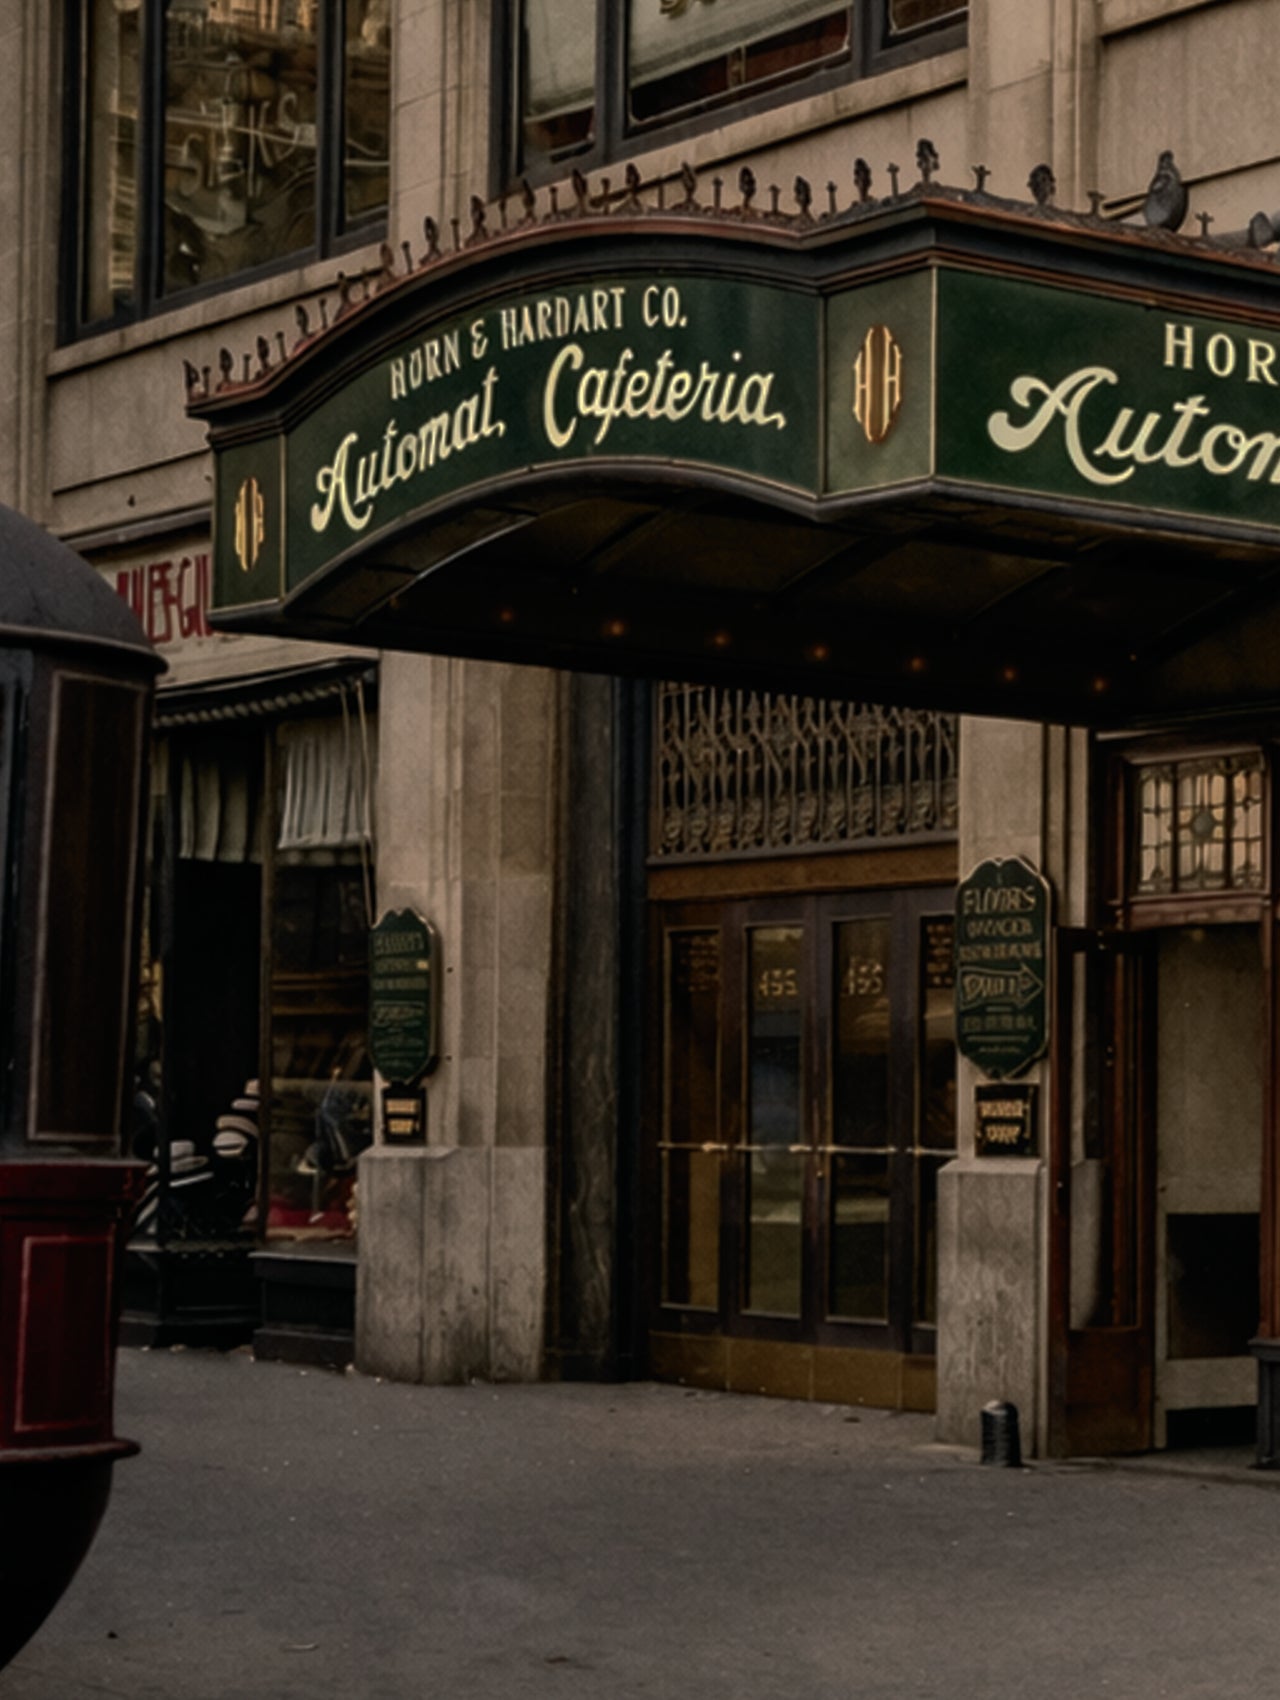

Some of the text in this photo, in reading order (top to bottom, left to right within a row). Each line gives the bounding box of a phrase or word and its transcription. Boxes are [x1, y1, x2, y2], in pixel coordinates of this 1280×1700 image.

[390, 285, 687, 399] HORN & HARDART CO.
[311, 366, 505, 532] Automat
[544, 343, 786, 449] Cafeteria
